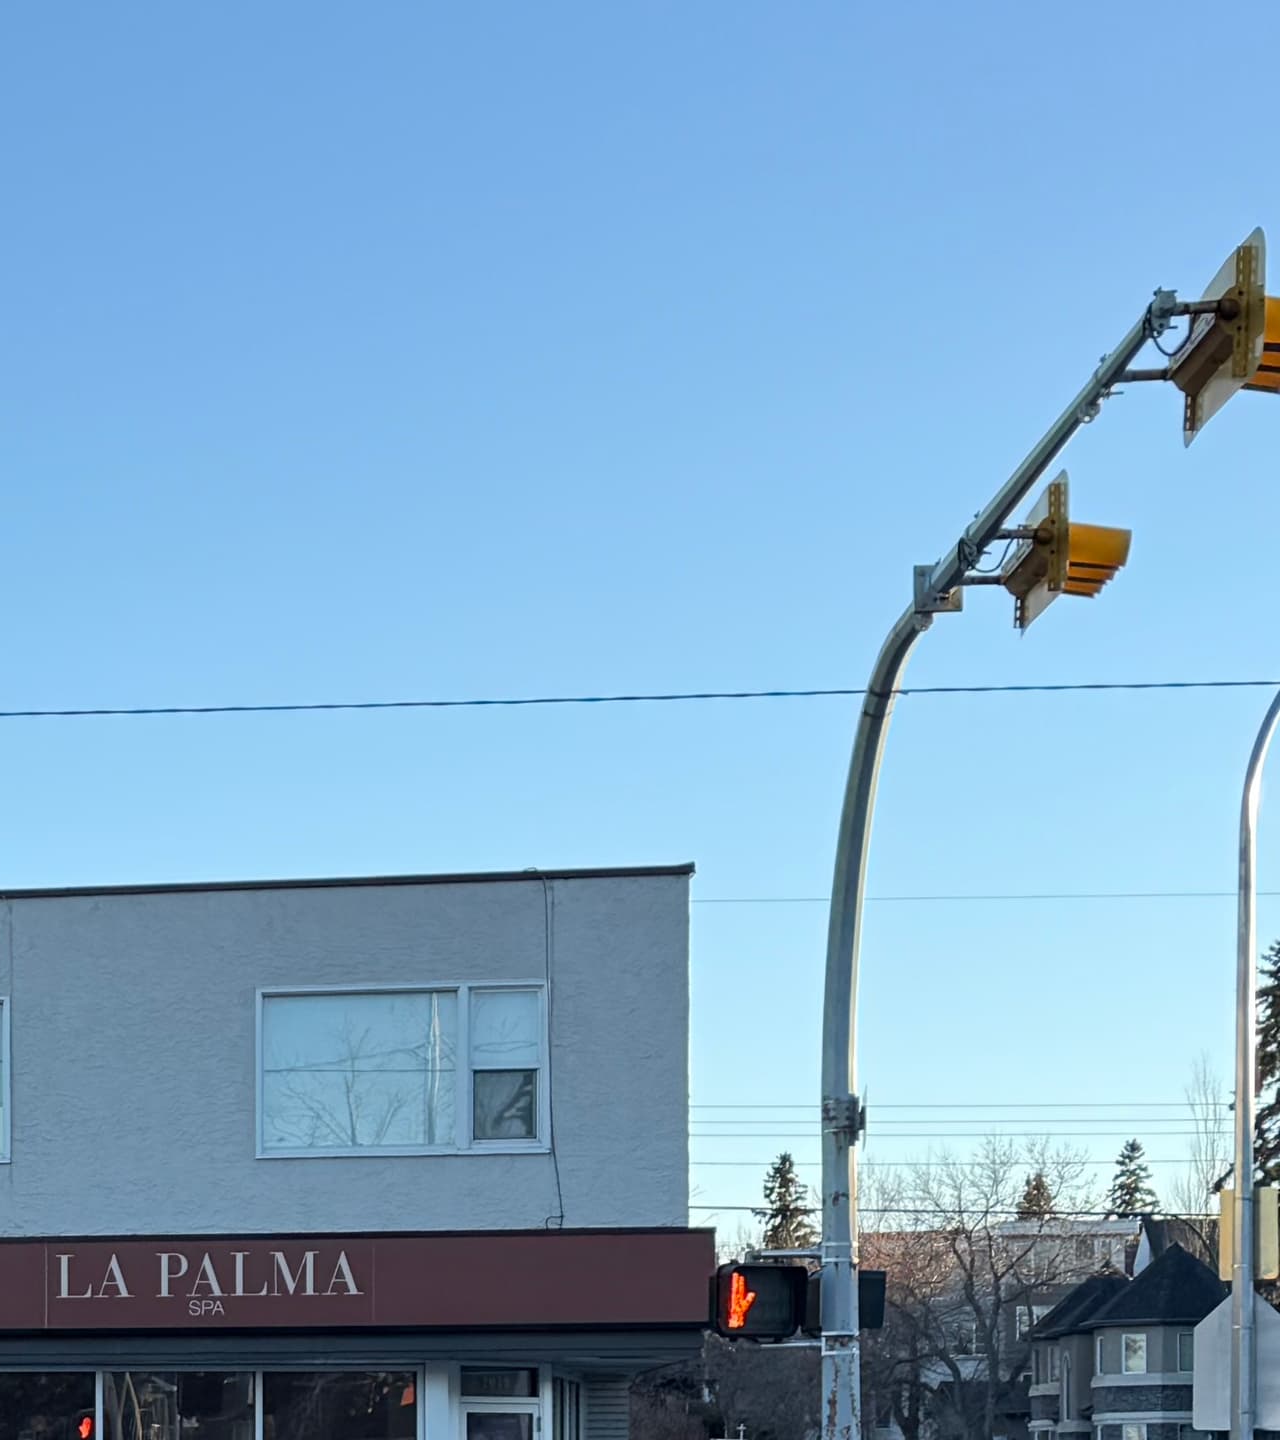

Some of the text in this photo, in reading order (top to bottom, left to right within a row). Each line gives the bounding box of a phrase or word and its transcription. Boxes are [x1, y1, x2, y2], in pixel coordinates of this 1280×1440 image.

[54, 1250, 364, 1299] LA PALMA
[188, 1299, 225, 1317] SPA
